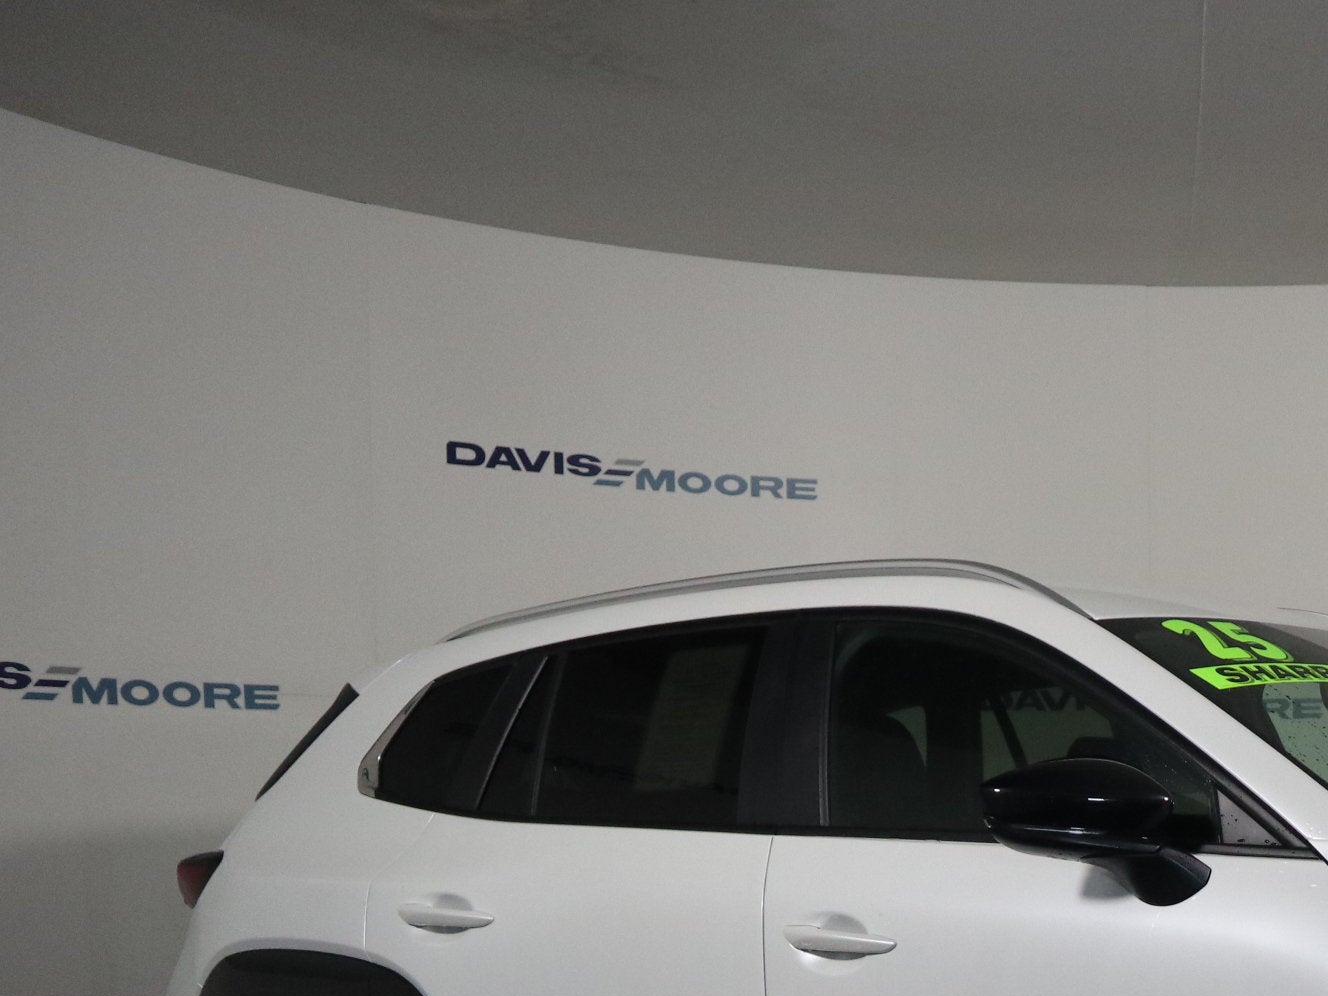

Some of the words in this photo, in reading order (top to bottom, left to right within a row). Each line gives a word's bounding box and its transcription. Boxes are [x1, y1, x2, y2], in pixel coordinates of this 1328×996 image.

[446, 441, 602, 477] DAVIS
[635, 468, 818, 500] MOORE
[1161, 619, 1293, 661] 25
[71, 676, 280, 710] MOORE
